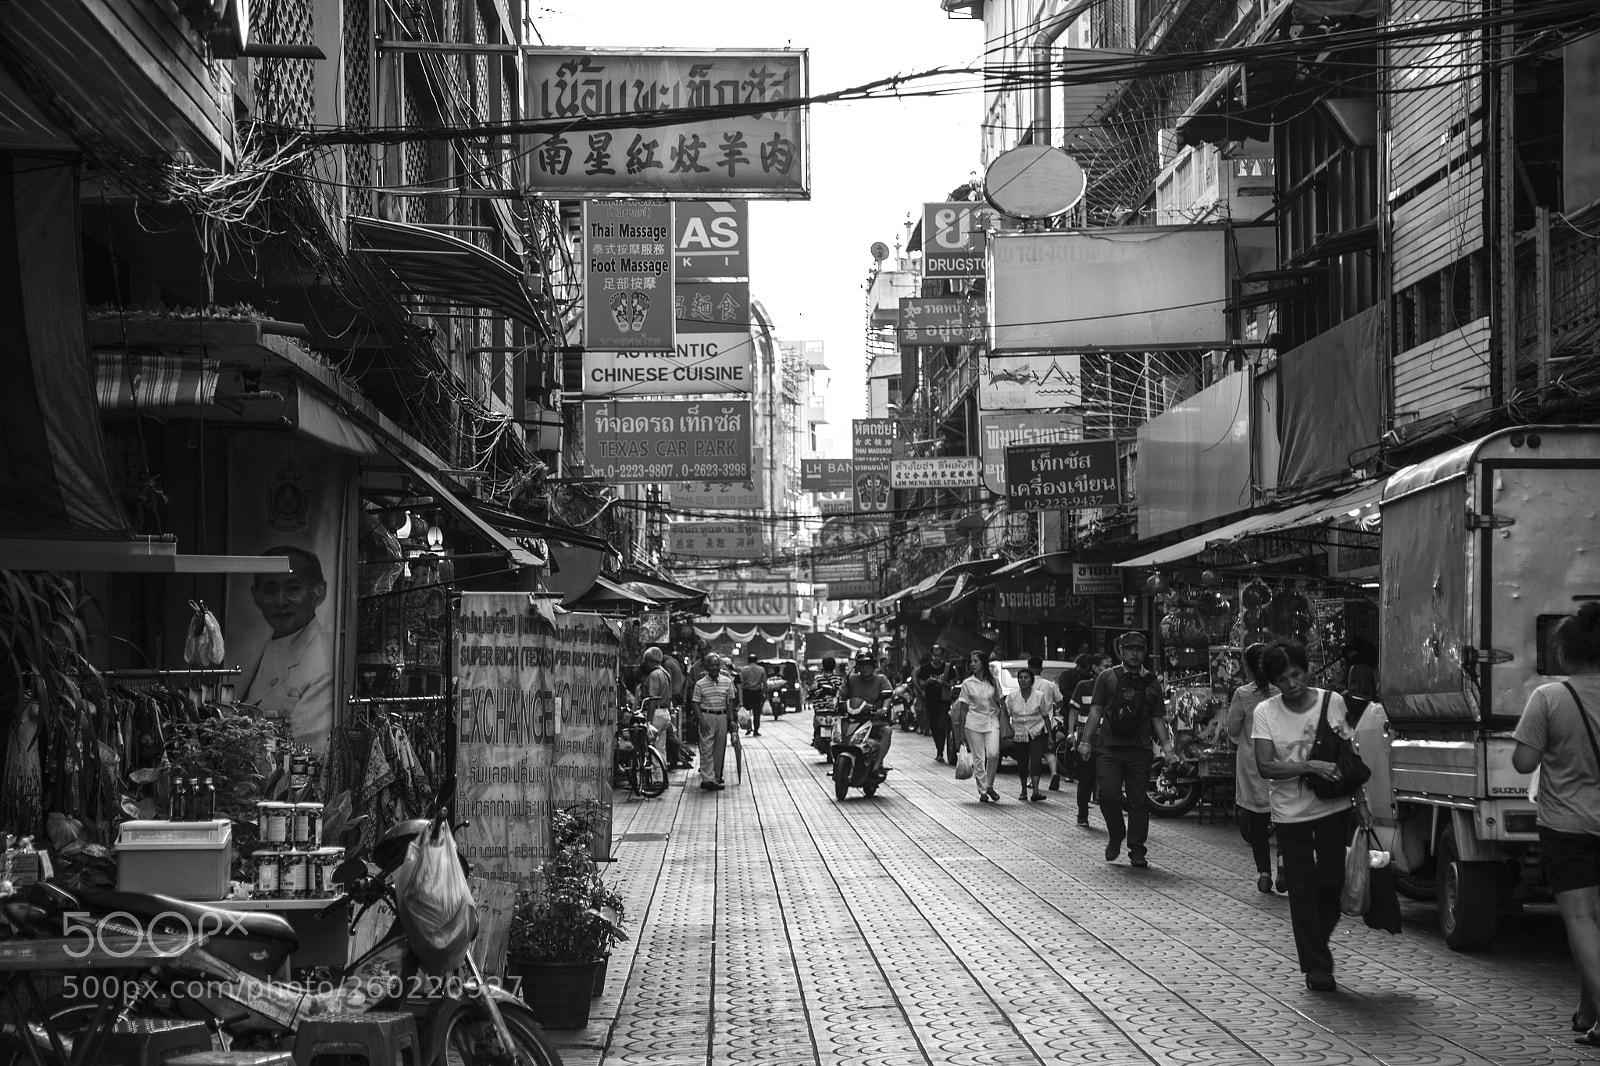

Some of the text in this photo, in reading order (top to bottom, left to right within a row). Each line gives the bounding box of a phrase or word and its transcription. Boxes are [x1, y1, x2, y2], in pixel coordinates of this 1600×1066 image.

[539, 132, 794, 178] 南星紅炆羊肉
[591, 223, 667, 242] Thai Massage
[675, 216, 739, 249] AS
[591, 258, 669, 276] Foot Massage
[929, 257, 986, 272] DRUGSTO
[603, 277, 657, 291] 足部按摩
[591, 366, 743, 382] CHINESE CUISINE
[595, 403, 741, 433] ที่จอดรถ เท็กซัส
[599, 439, 738, 457] TEXAS CAR PARK
[681, 462, 747, 477] 0-2623-3298
[806, 462, 853, 474] LH BAN
[1031, 450, 1091, 473] เท็กซัส
[1010, 474, 1116, 498] เครื่องเขียน
[1024, 494, 1104, 511] 02-223-9437
[460, 646, 493, 666] SUPER
[494, 646, 519, 666] RICH
[572, 651, 590, 667] RICH
[459, 688, 554, 745] EXCHANGE
[1492, 787, 1529, 795] SUZUK
